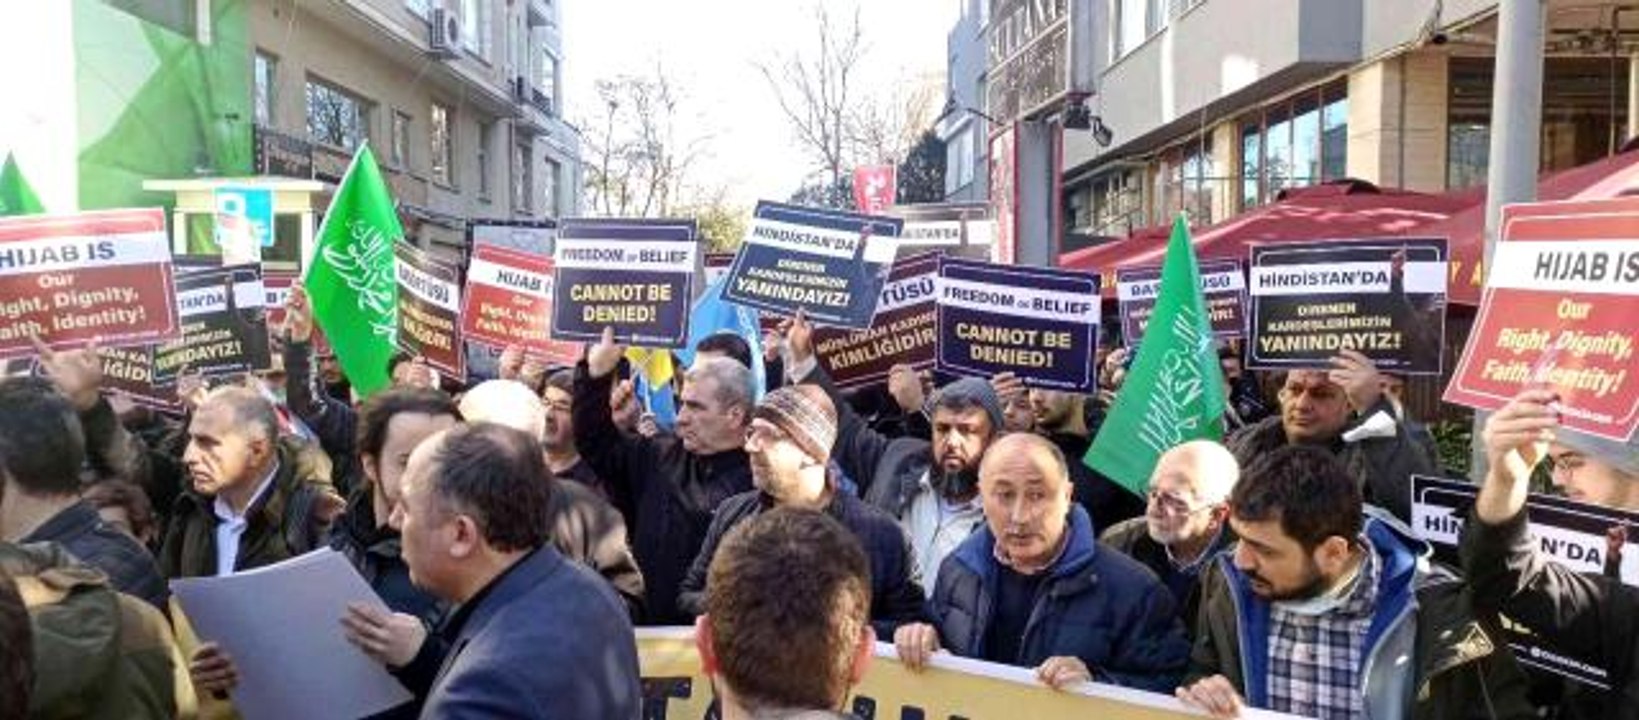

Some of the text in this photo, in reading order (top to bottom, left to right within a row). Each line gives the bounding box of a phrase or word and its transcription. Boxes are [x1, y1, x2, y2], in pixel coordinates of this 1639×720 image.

[0, 240, 116, 268] HIJAB IS
[561, 248, 624, 262] FREEDOM
[639, 249, 679, 263] BELIEF
[1533, 251, 1639, 283] HIJAB IS
[37, 273, 75, 290] Our
[497, 270, 541, 291] HIJAB
[1259, 268, 1389, 289] HİNDİSTAN'DA
[0, 287, 140, 319] ight, Dignity,
[571, 283, 672, 302] CANNOT BE
[944, 286, 1015, 306] FREEDOM
[1031, 297, 1091, 315] BELIEF
[583, 304, 657, 323] DENIED!
[1557, 298, 1593, 320] Our
[0, 304, 148, 339] aith, Identity!
[956, 322, 1072, 349] CANNOT BE
[1259, 332, 1401, 353] YANINDAYIZ!
[970, 345, 1054, 368] DENIED!
